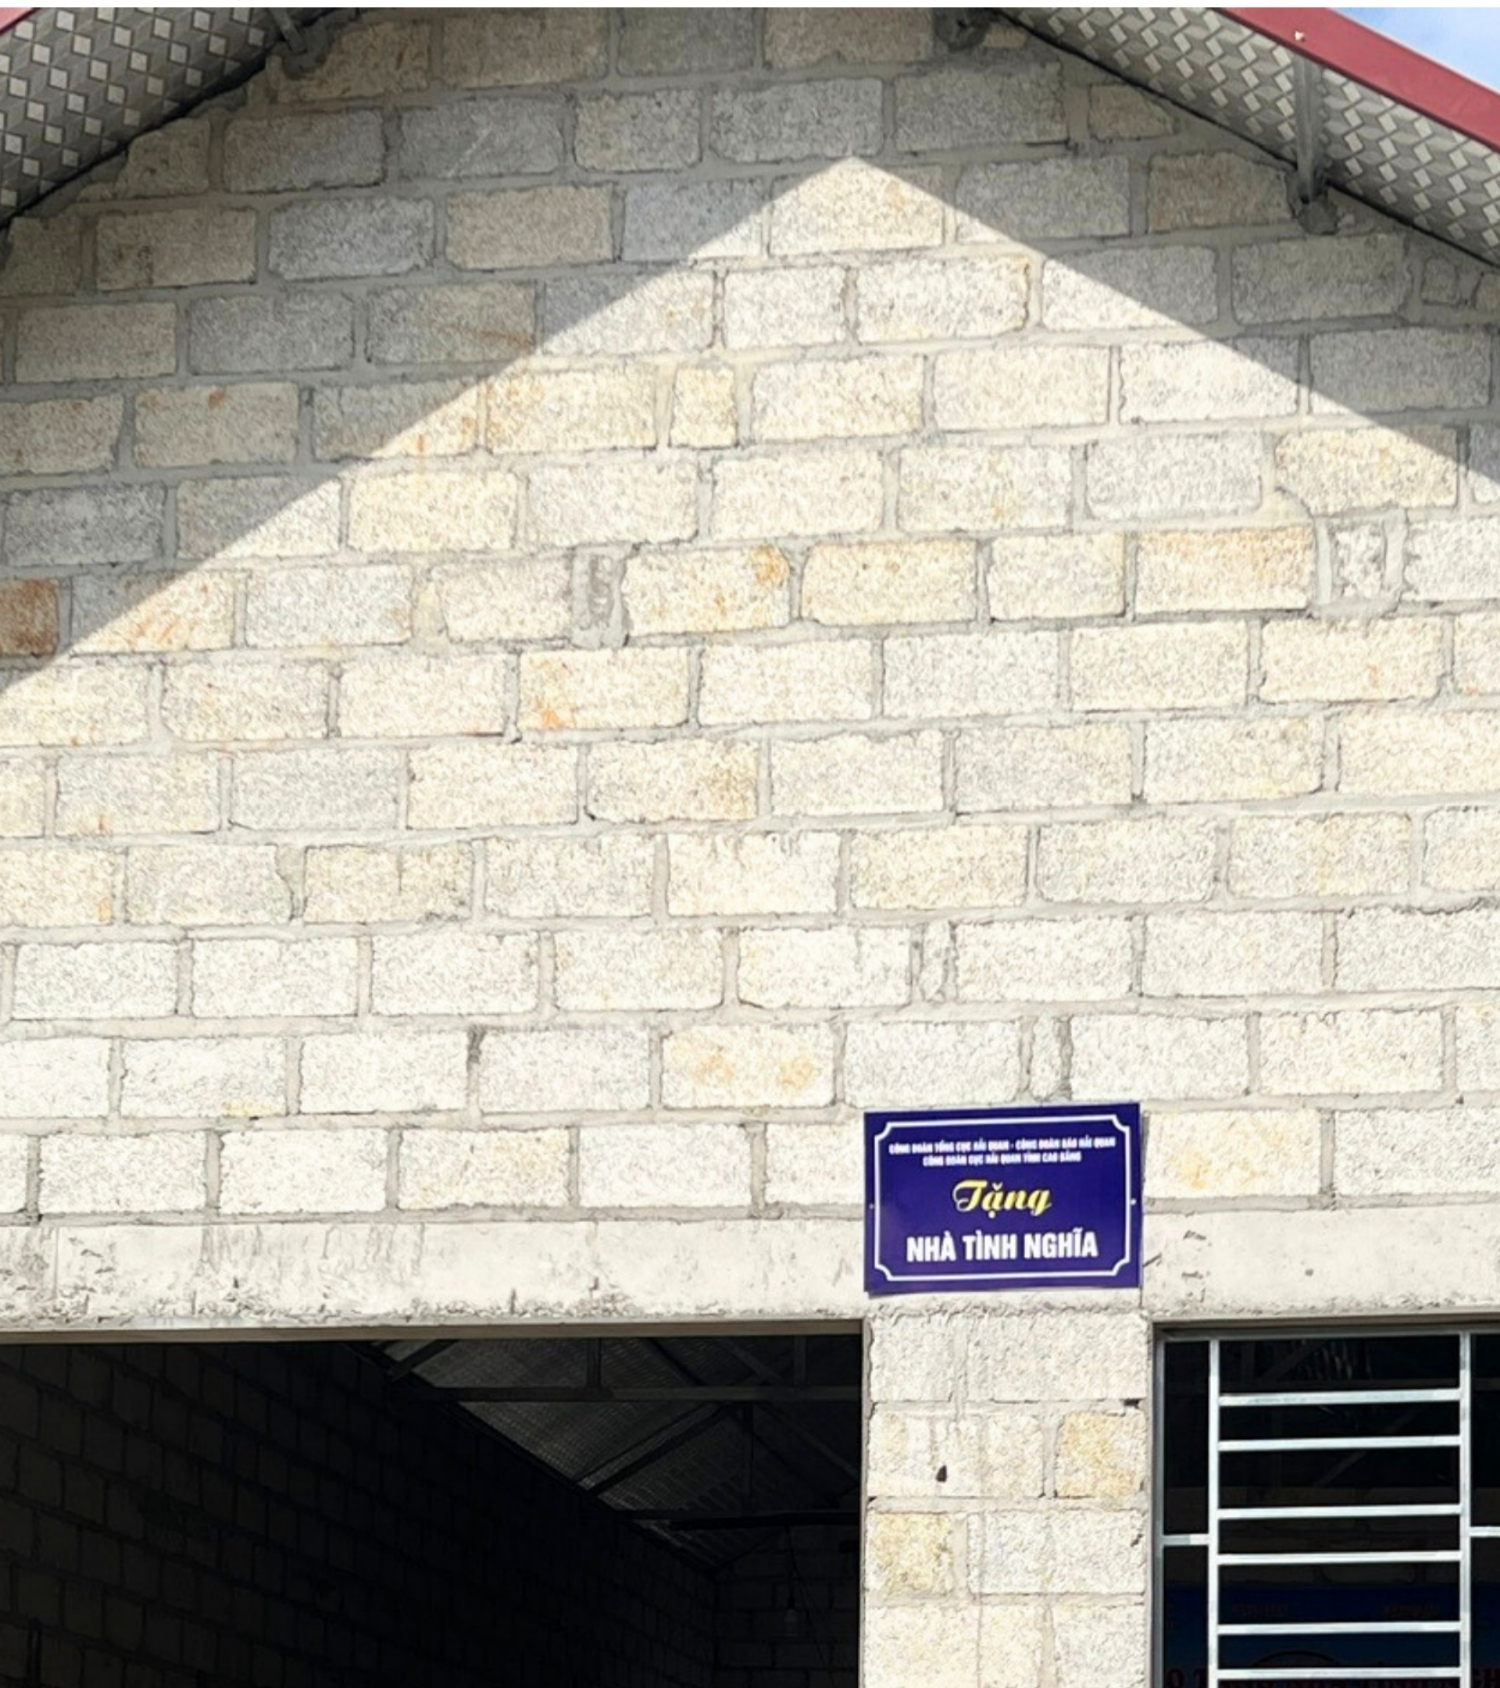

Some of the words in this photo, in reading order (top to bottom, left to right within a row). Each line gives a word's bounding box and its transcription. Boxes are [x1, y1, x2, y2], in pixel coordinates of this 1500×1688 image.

[953, 1179, 1052, 1219] Tặng
[906, 1230, 956, 1262] NHÀ
[963, 1229, 1017, 1260] TÌNH
[1024, 1227, 1098, 1259] NGHĨA
